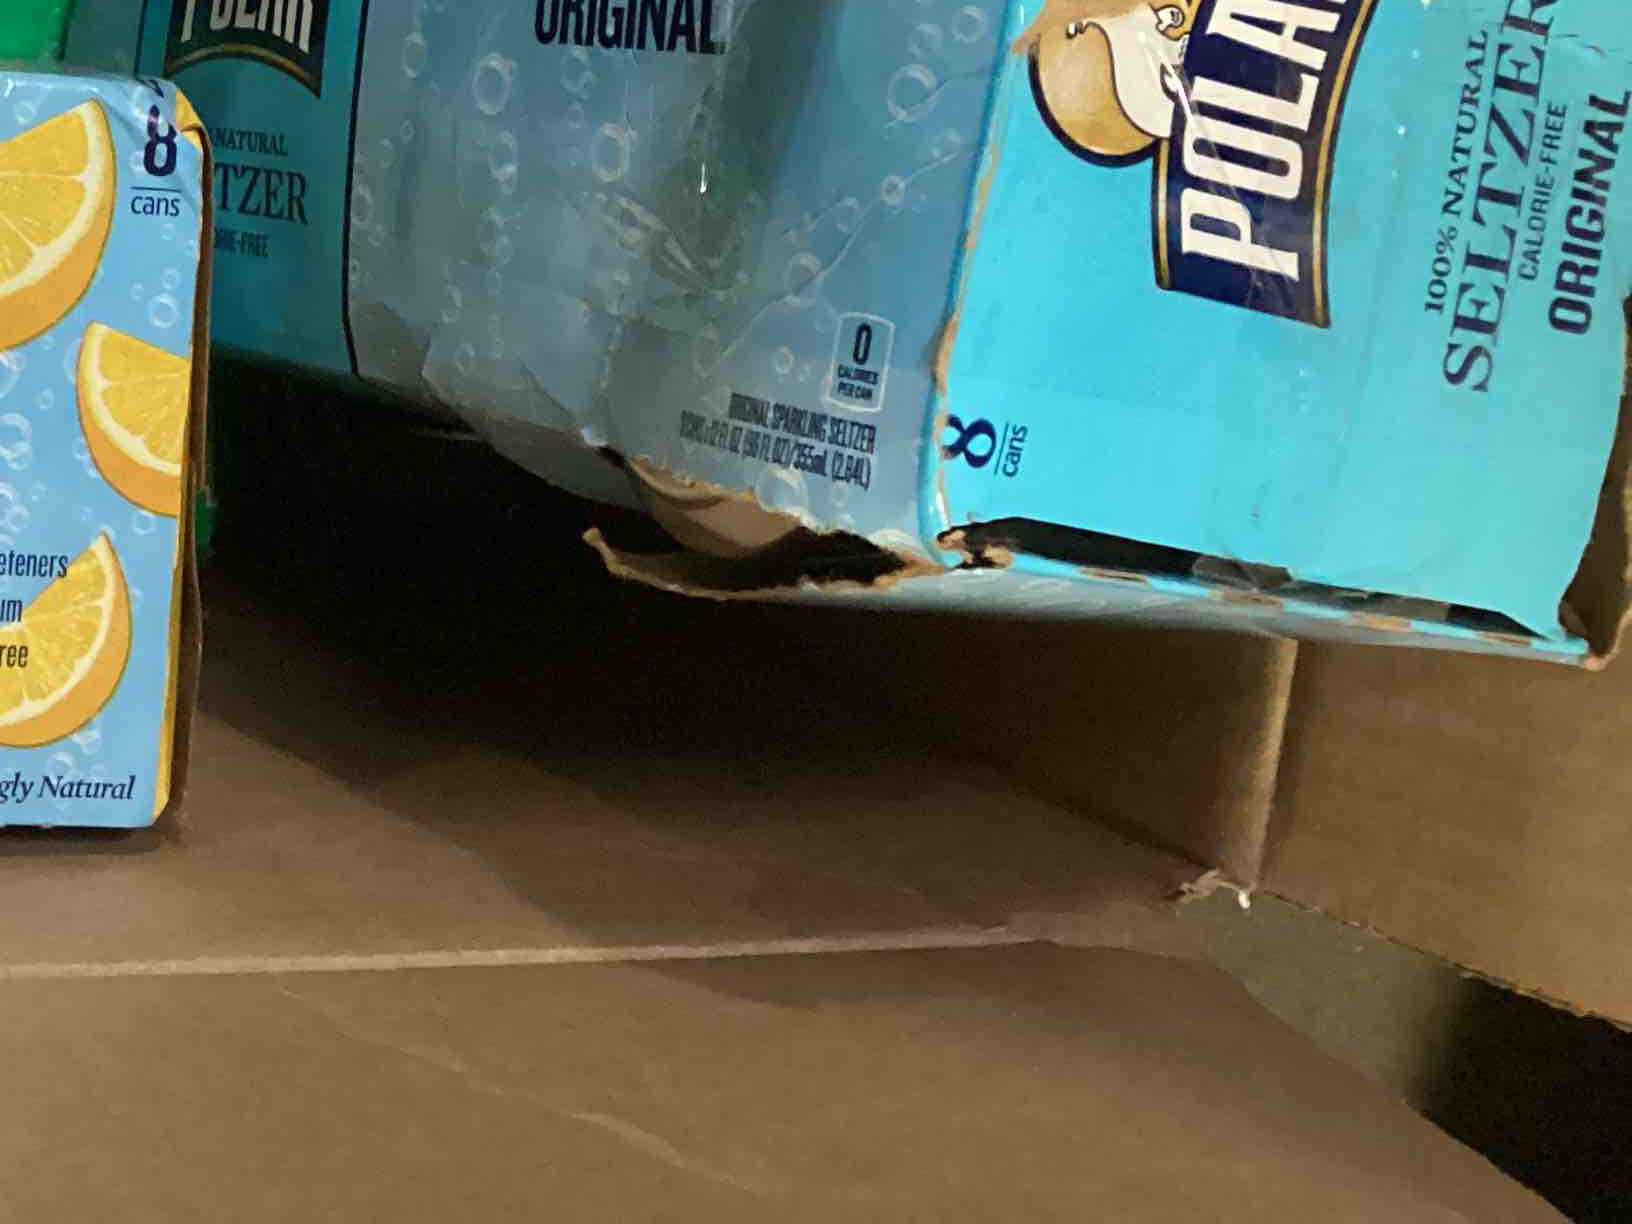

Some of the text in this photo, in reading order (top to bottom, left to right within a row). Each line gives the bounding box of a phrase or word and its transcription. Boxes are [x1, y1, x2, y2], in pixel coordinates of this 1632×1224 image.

[1424, 28, 1490, 316] 100% NATURAL
[1516, 101, 1568, 282] CALORIE-FREE
[130, 194, 181, 218] cans
[1547, 88, 1632, 336] ORIGINAL
[852, 323, 872, 365] 0
[827, 415, 877, 456] SELTZER
[943, 412, 997, 469] 8
[1001, 422, 1028, 477] cans
[38, 774, 136, 801] Natural
